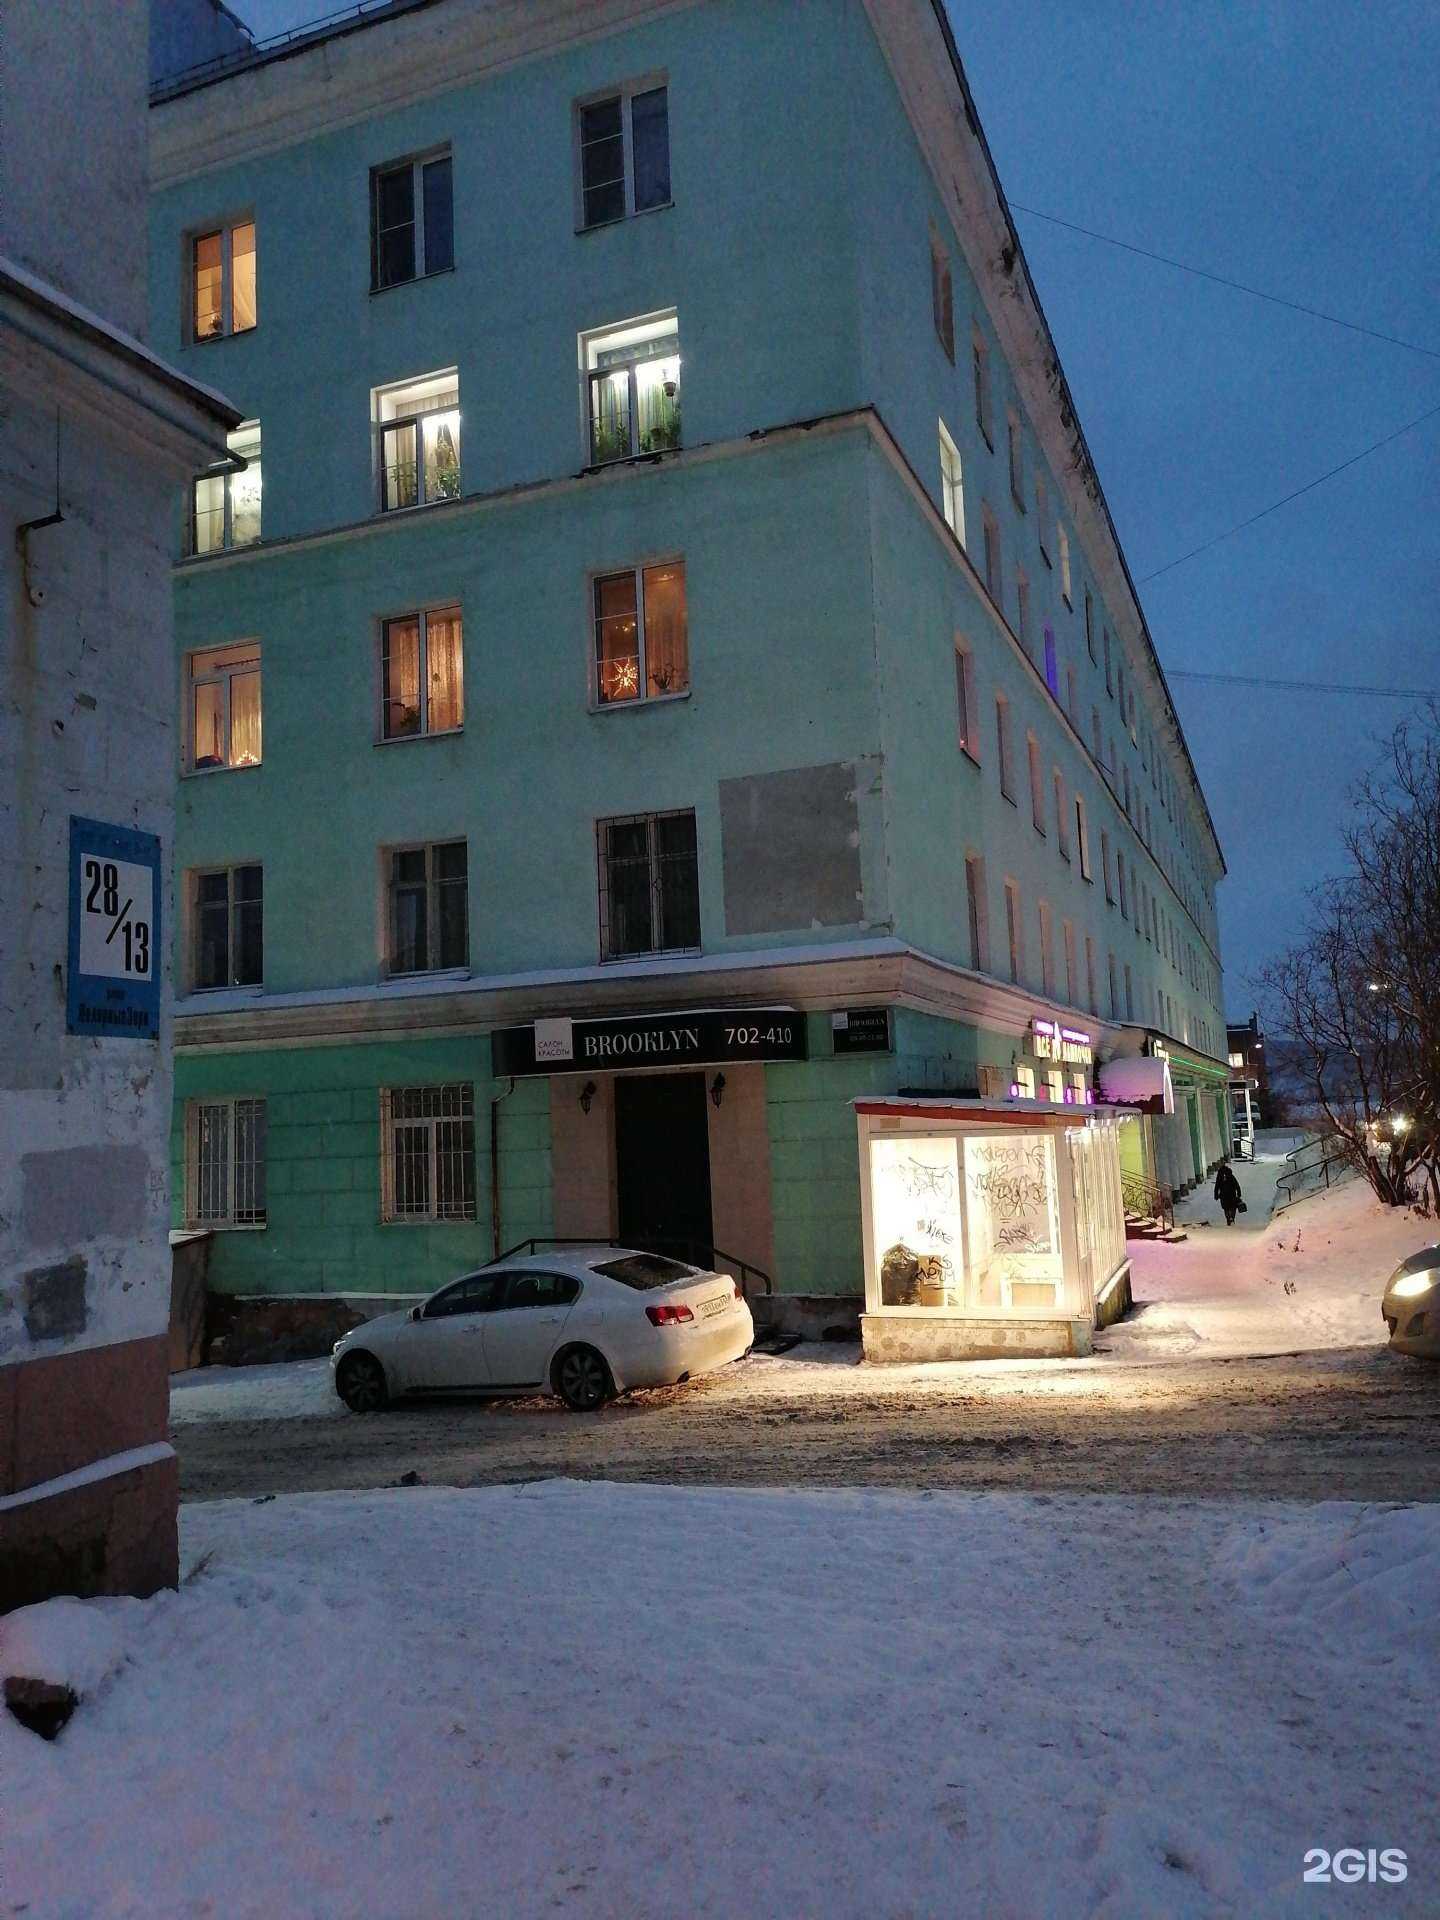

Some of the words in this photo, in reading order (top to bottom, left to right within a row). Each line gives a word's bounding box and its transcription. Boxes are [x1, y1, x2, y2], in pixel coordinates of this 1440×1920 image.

[85, 860, 149, 974] 28/13
[538, 1040, 563, 1049] САЛОН
[584, 1028, 700, 1057] BROOKLYN
[724, 1027, 792, 1046] 702-410
